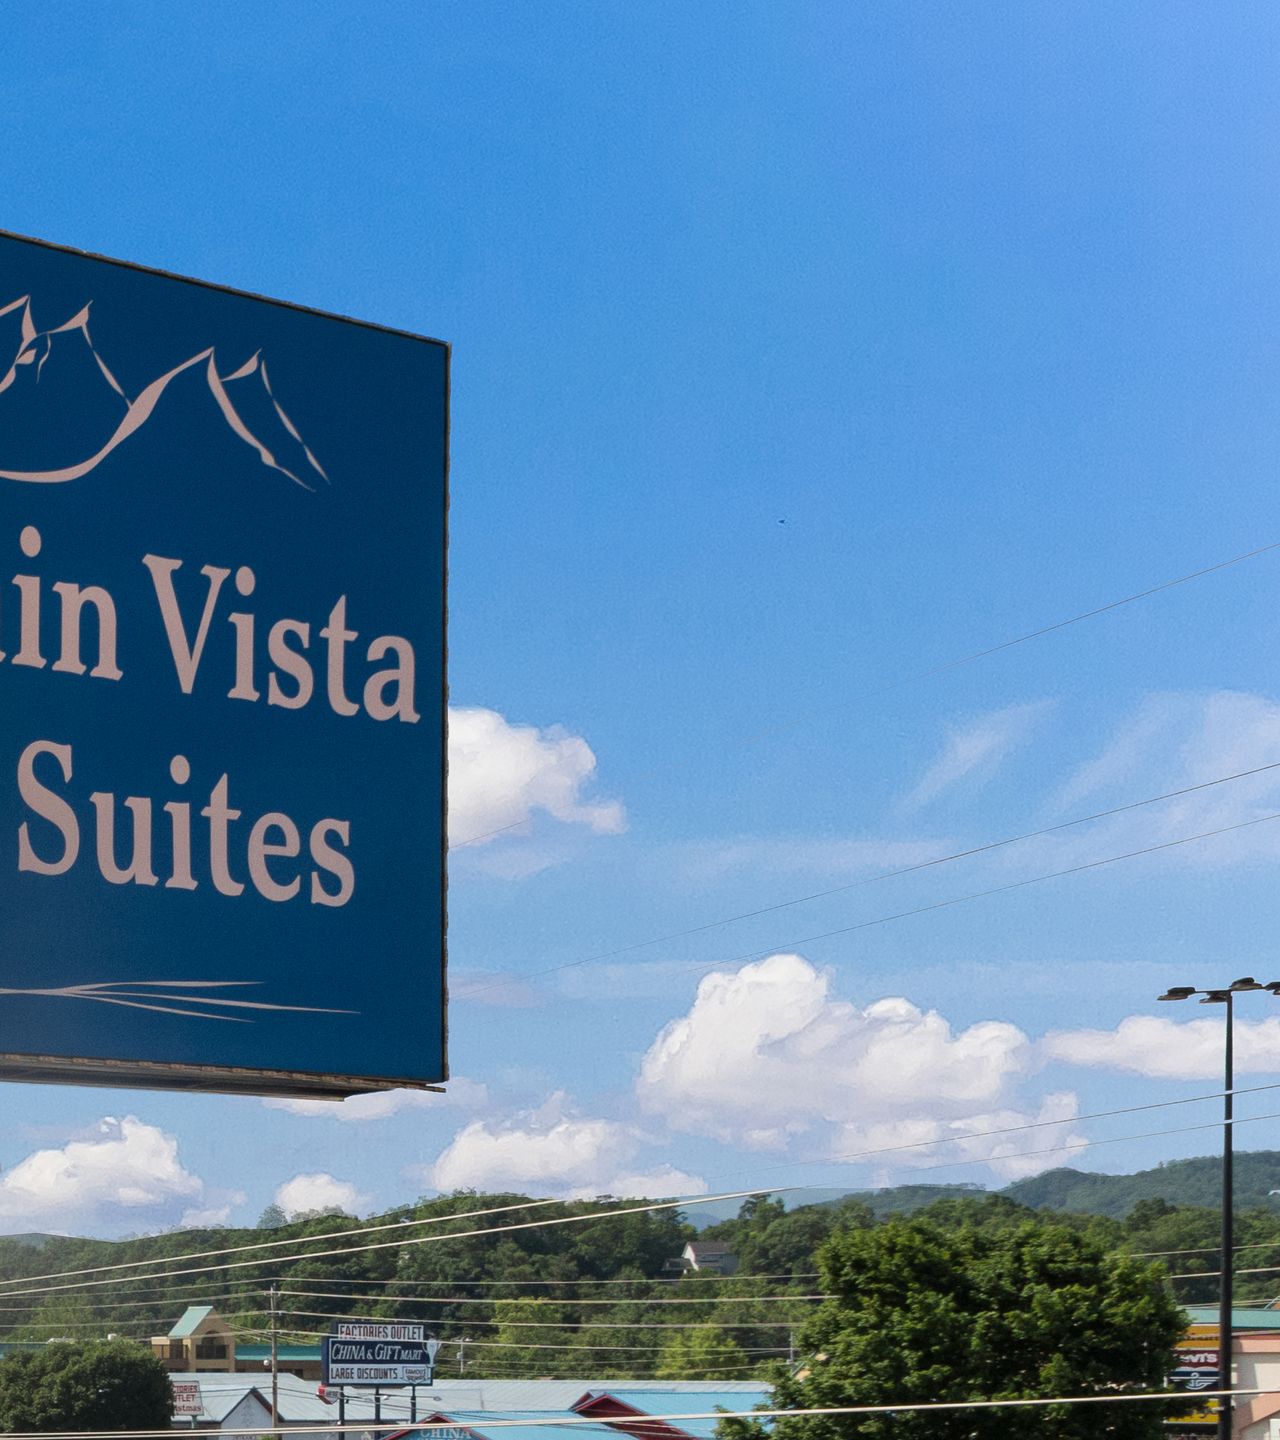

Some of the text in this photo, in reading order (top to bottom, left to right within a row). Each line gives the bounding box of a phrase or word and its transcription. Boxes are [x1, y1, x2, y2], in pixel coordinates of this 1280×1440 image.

[142, 555, 421, 723] Vista
[18, 740, 355, 907] Suites
[339, 1325, 423, 1340] FACTORIES OUTLET
[332, 1343, 423, 1360] CHINA & GIFT MART
[330, 1367, 355, 1380] LARGE
[356, 1367, 398, 1380] DISCOUNTS
[420, 1427, 472, 1439] CHINA
